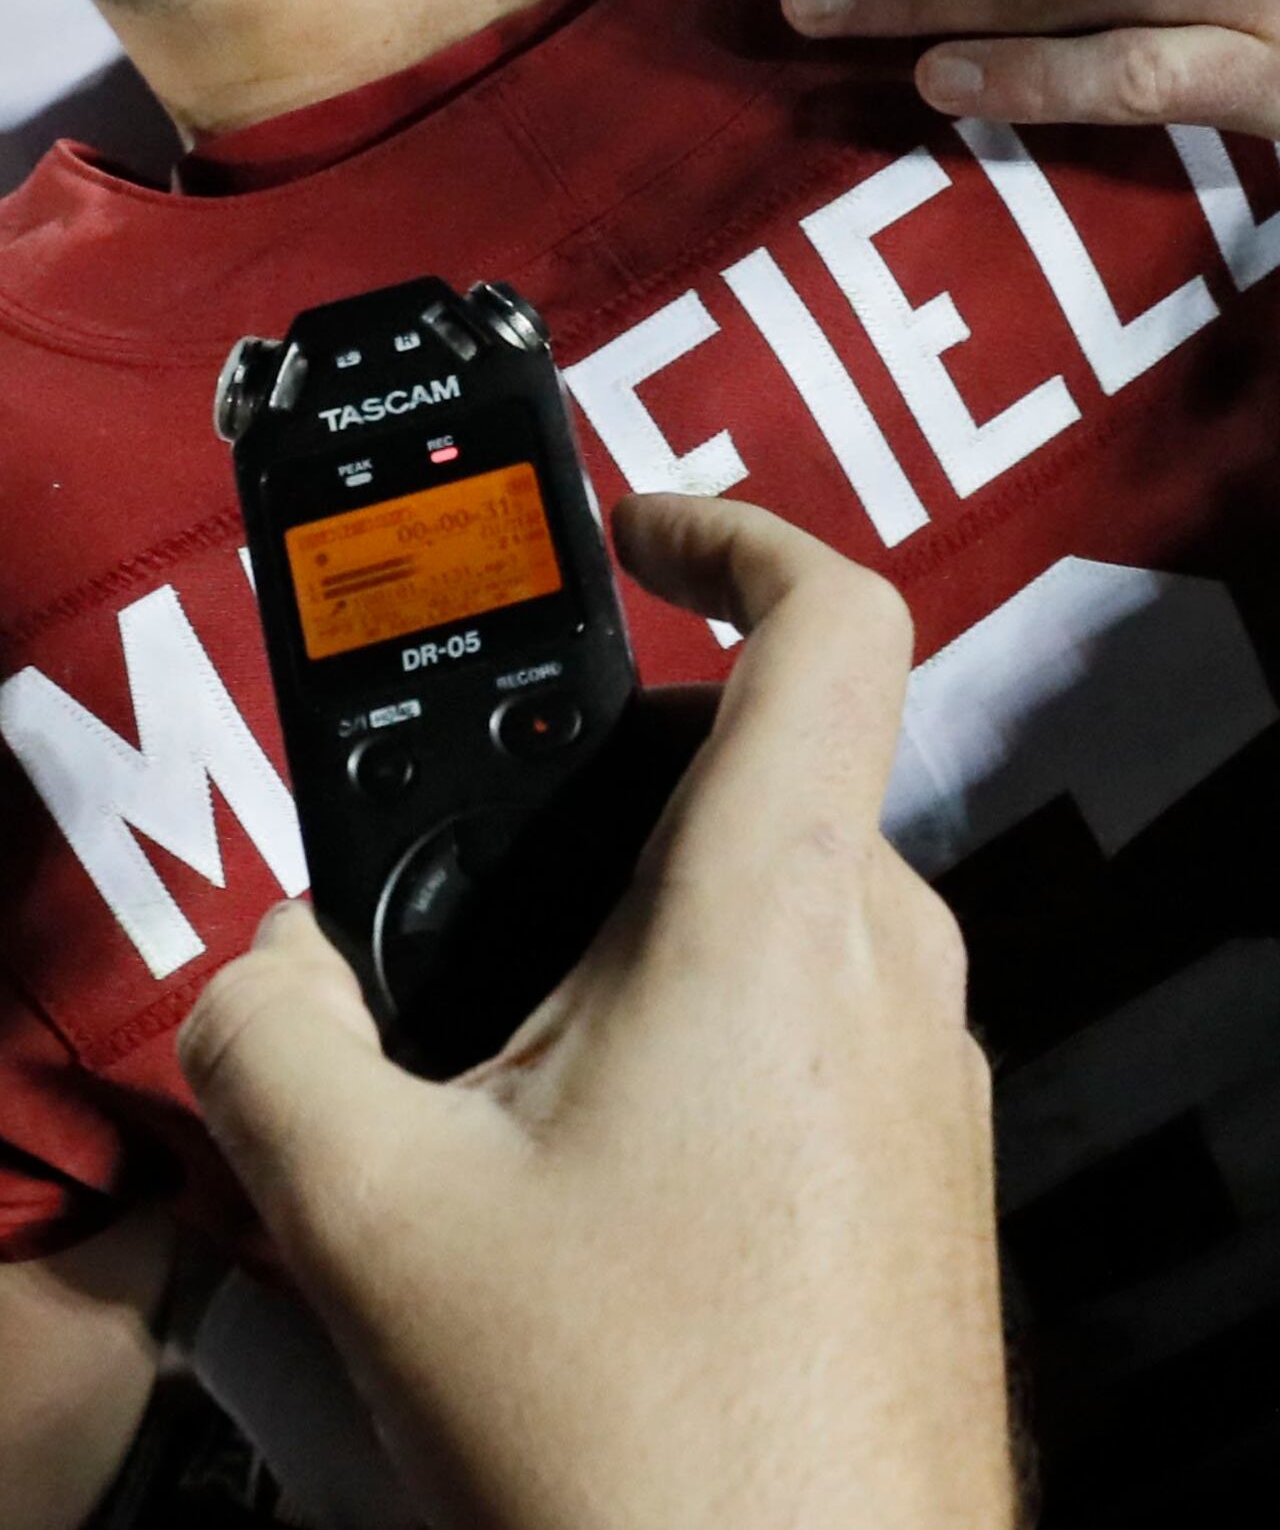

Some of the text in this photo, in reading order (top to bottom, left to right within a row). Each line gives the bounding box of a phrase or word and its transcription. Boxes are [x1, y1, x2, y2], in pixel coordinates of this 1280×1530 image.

[318, 375, 461, 432] TASCAM
[427, 435, 455, 451] REC
[338, 459, 373, 477] PEAK
[402, 630, 482, 671] DR-05
[496, 661, 563, 689] RECORD
